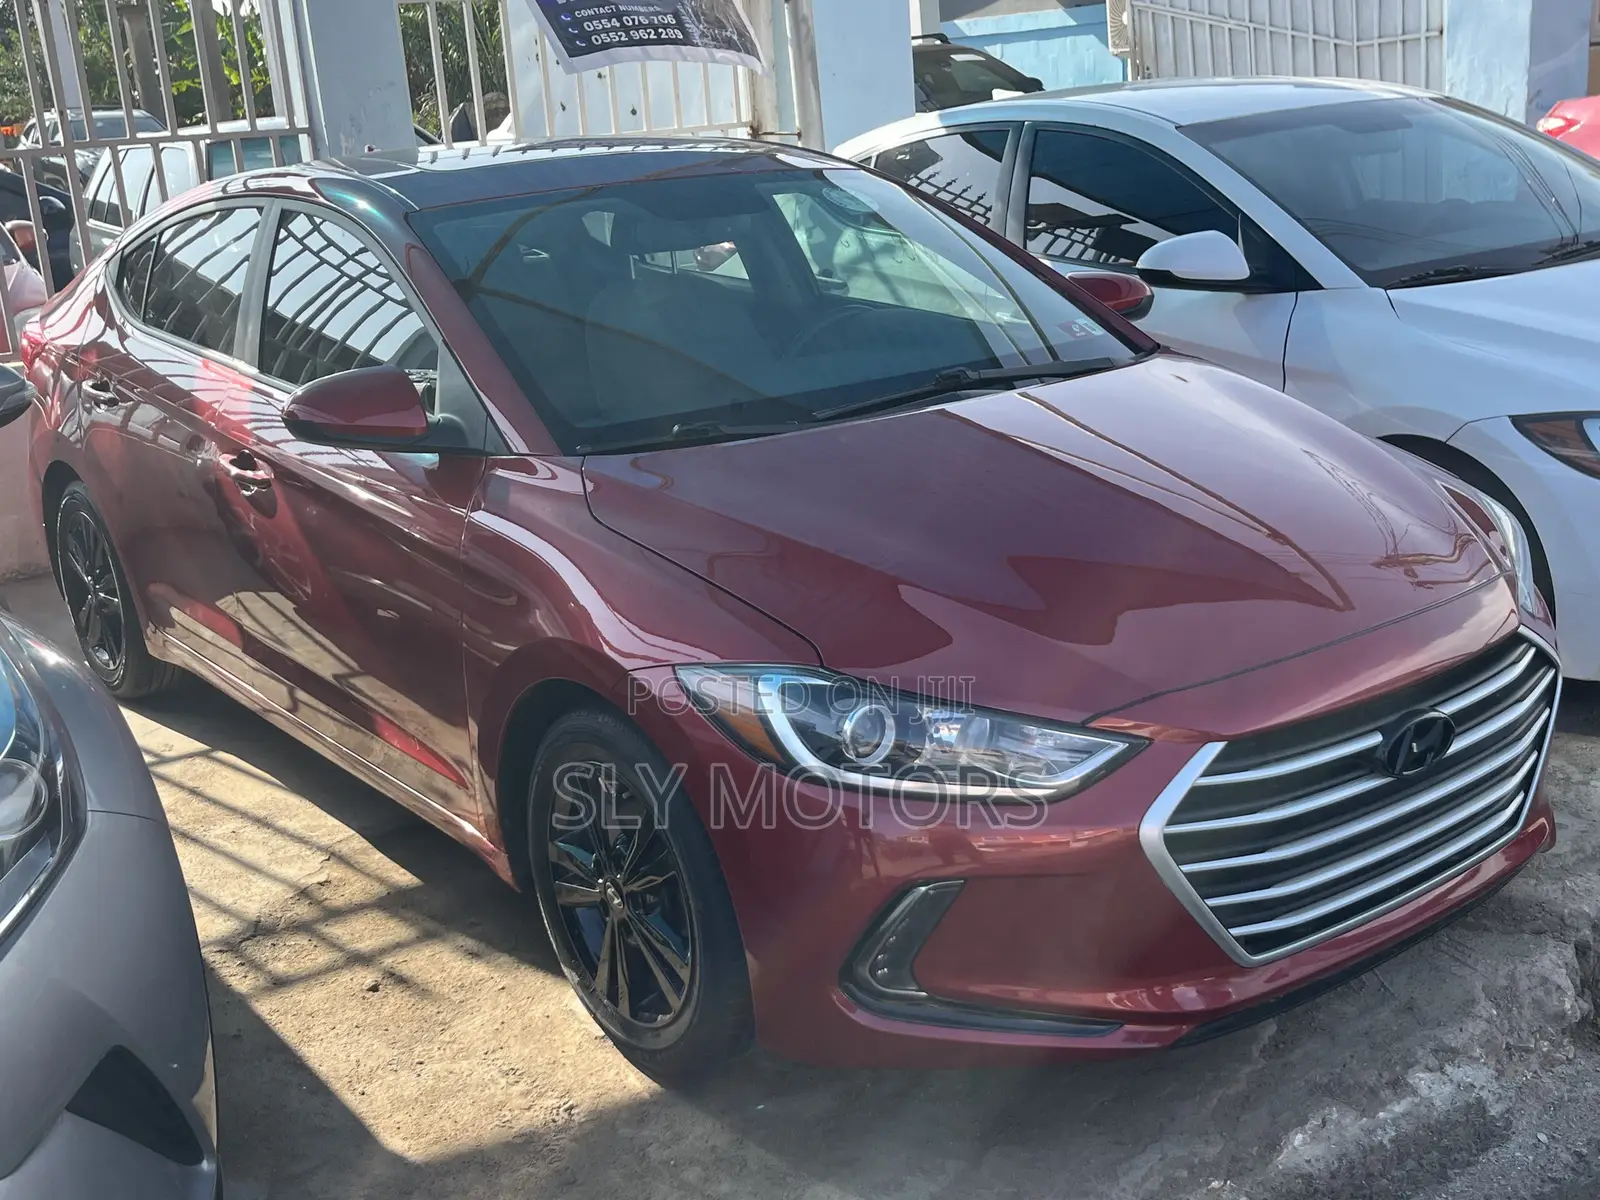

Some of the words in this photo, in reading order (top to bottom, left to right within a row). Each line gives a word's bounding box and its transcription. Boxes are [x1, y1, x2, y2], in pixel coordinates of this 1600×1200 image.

[574, 5, 616, 18] CONTACT
[583, 18, 621, 31] 0554
[591, 31, 629, 45] 0552
[629, 29, 658, 41] 962
[658, 28, 684, 40] 289
